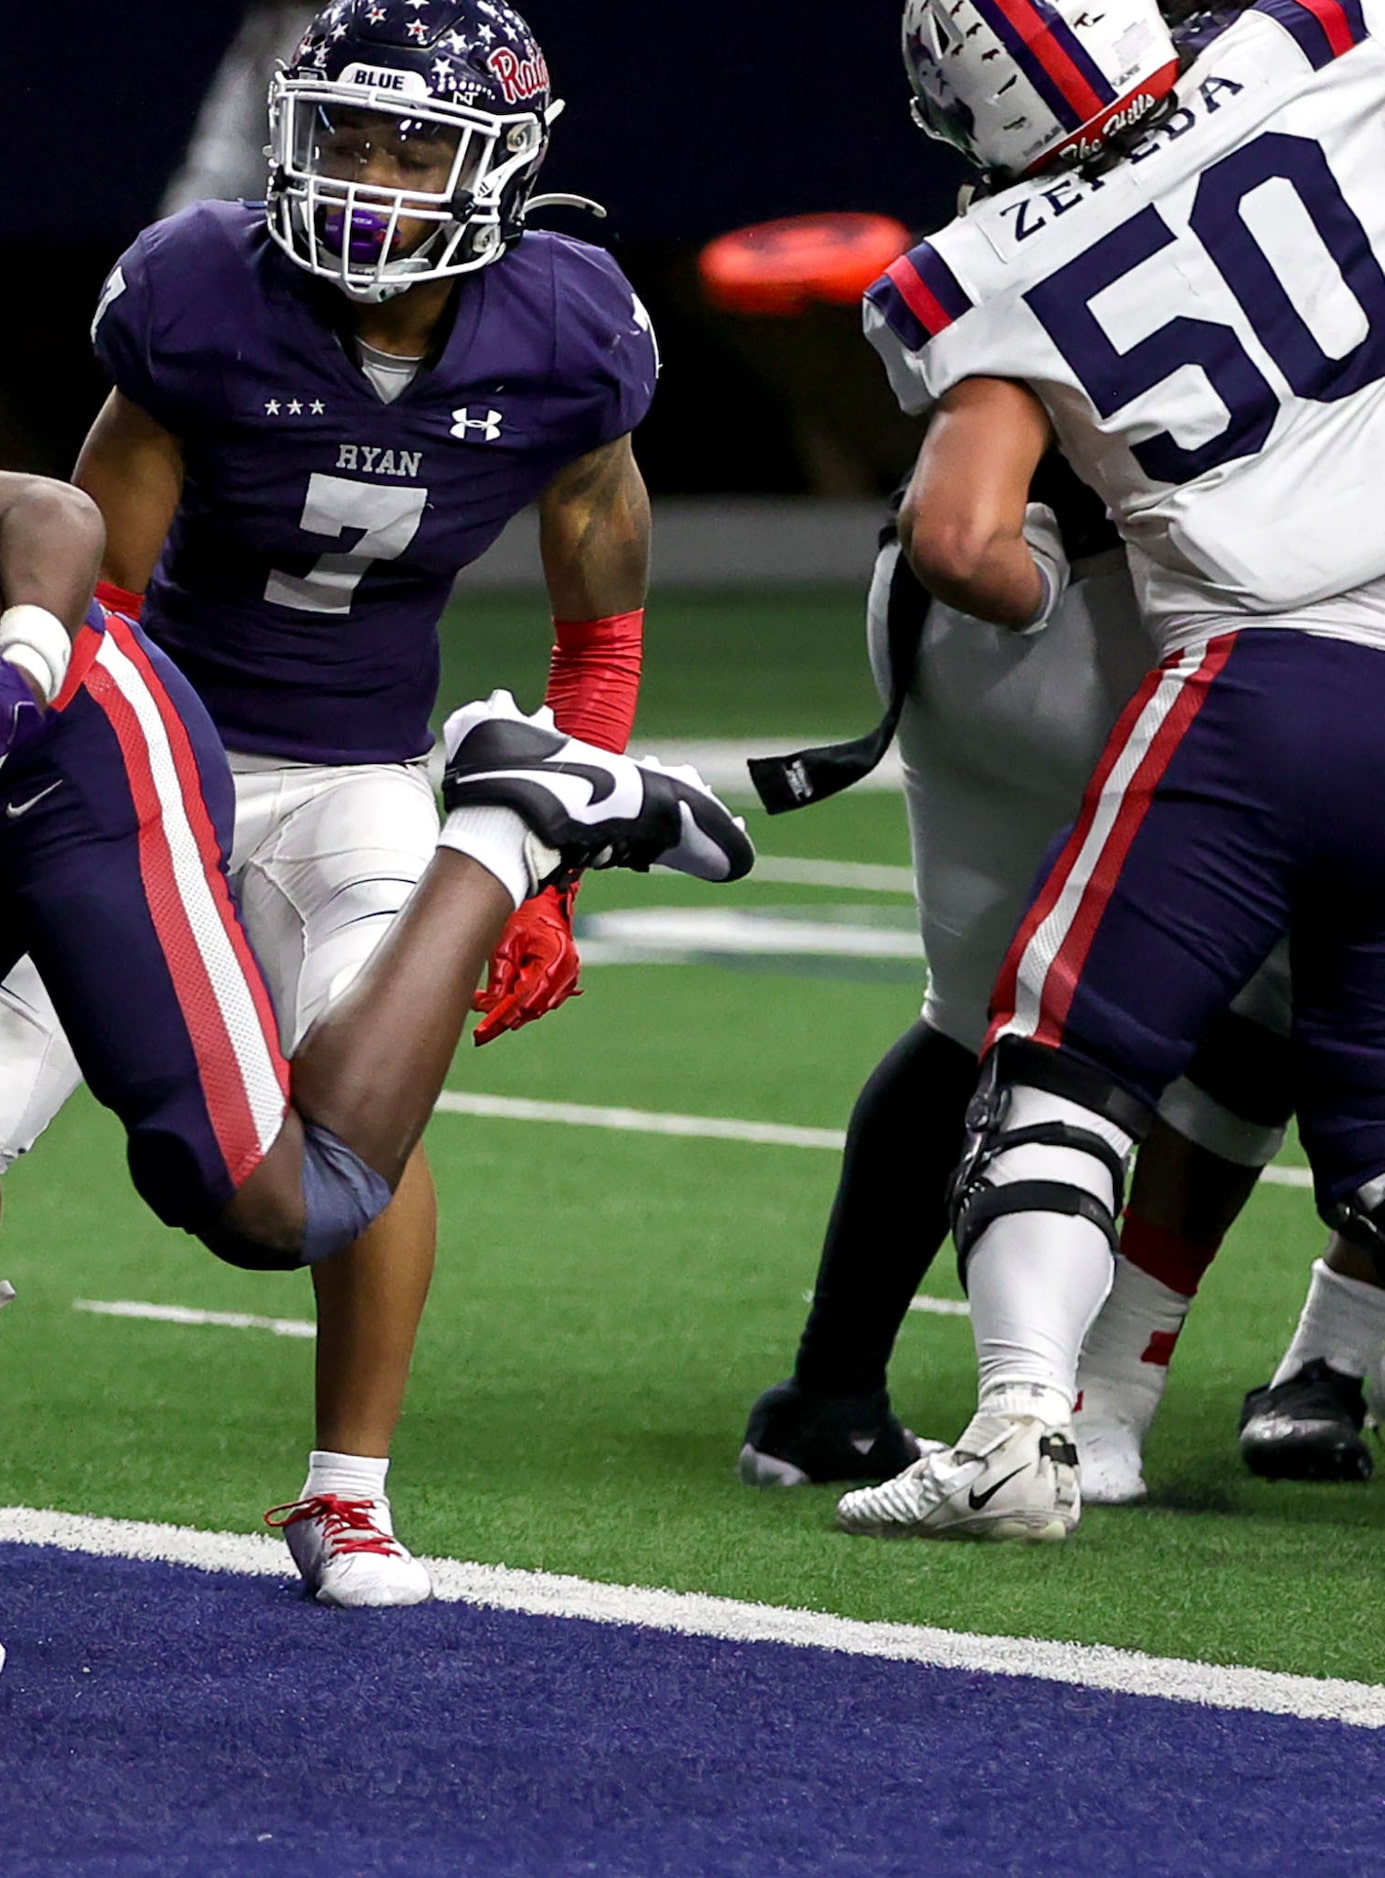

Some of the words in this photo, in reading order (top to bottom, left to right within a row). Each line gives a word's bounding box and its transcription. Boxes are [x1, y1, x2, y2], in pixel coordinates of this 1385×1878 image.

[354, 69, 405, 91] BLUE
[1058, 136, 1102, 160] The
[1102, 93, 1156, 137] Hills
[1022, 131, 1385, 485] 50
[336, 444, 423, 477] RYAN
[263, 473, 427, 614] 7
